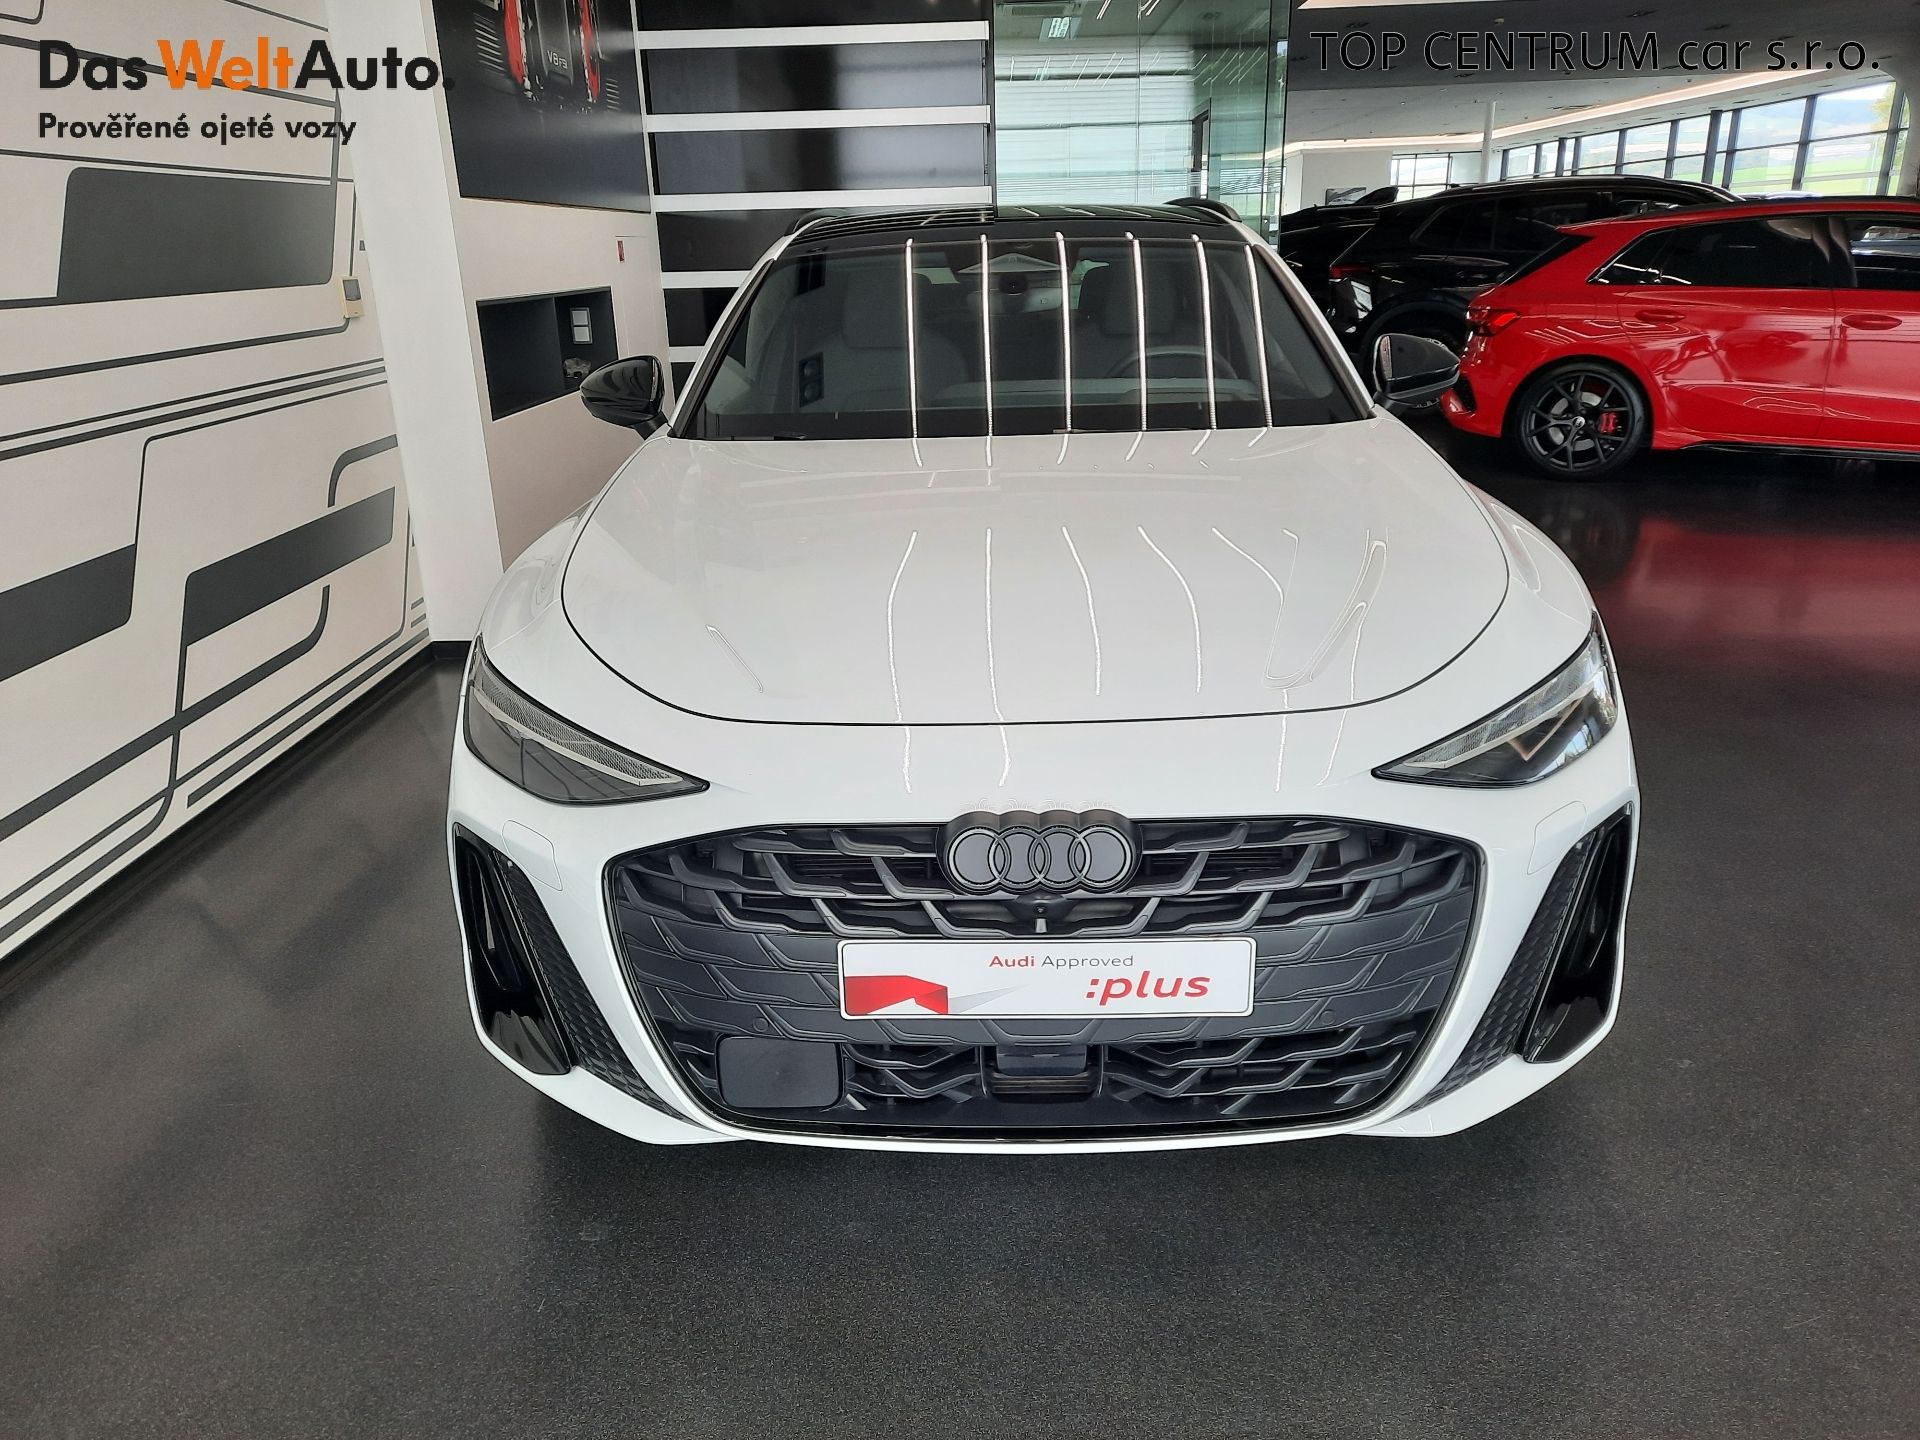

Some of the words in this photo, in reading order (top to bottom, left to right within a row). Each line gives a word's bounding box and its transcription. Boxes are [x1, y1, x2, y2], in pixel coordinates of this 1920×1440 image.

[989, 955, 1035, 968] Audi
[1041, 955, 1135, 970] Approved
[1086, 970, 1211, 1006] :plus
